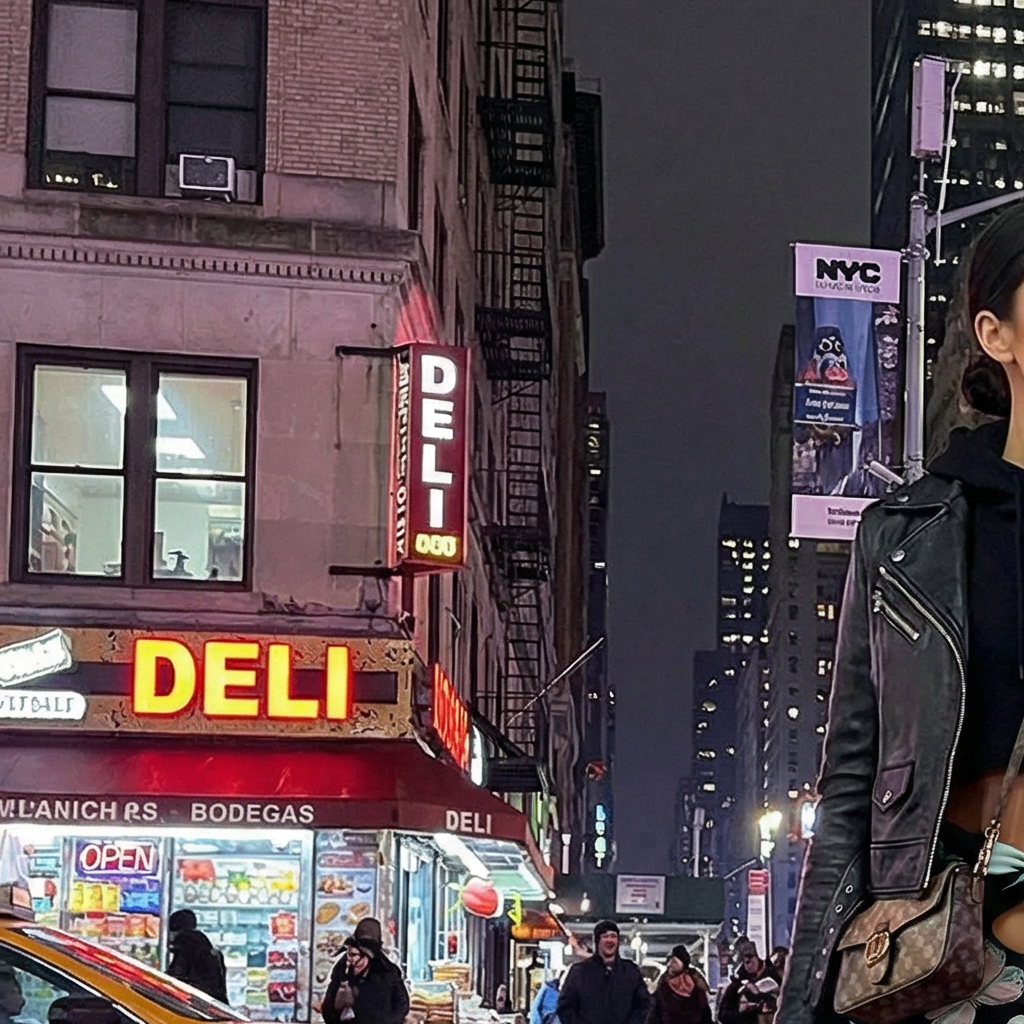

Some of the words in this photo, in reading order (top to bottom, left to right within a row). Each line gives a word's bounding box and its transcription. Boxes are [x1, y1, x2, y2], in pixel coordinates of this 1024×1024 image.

[816, 258, 881, 285] NYC
[421, 354, 457, 529] DELI
[133, 638, 350, 720] DELI
[190, 803, 314, 824] BODEGAS
[445, 810, 492, 834] DELI
[80, 844, 155, 872] OPEN
